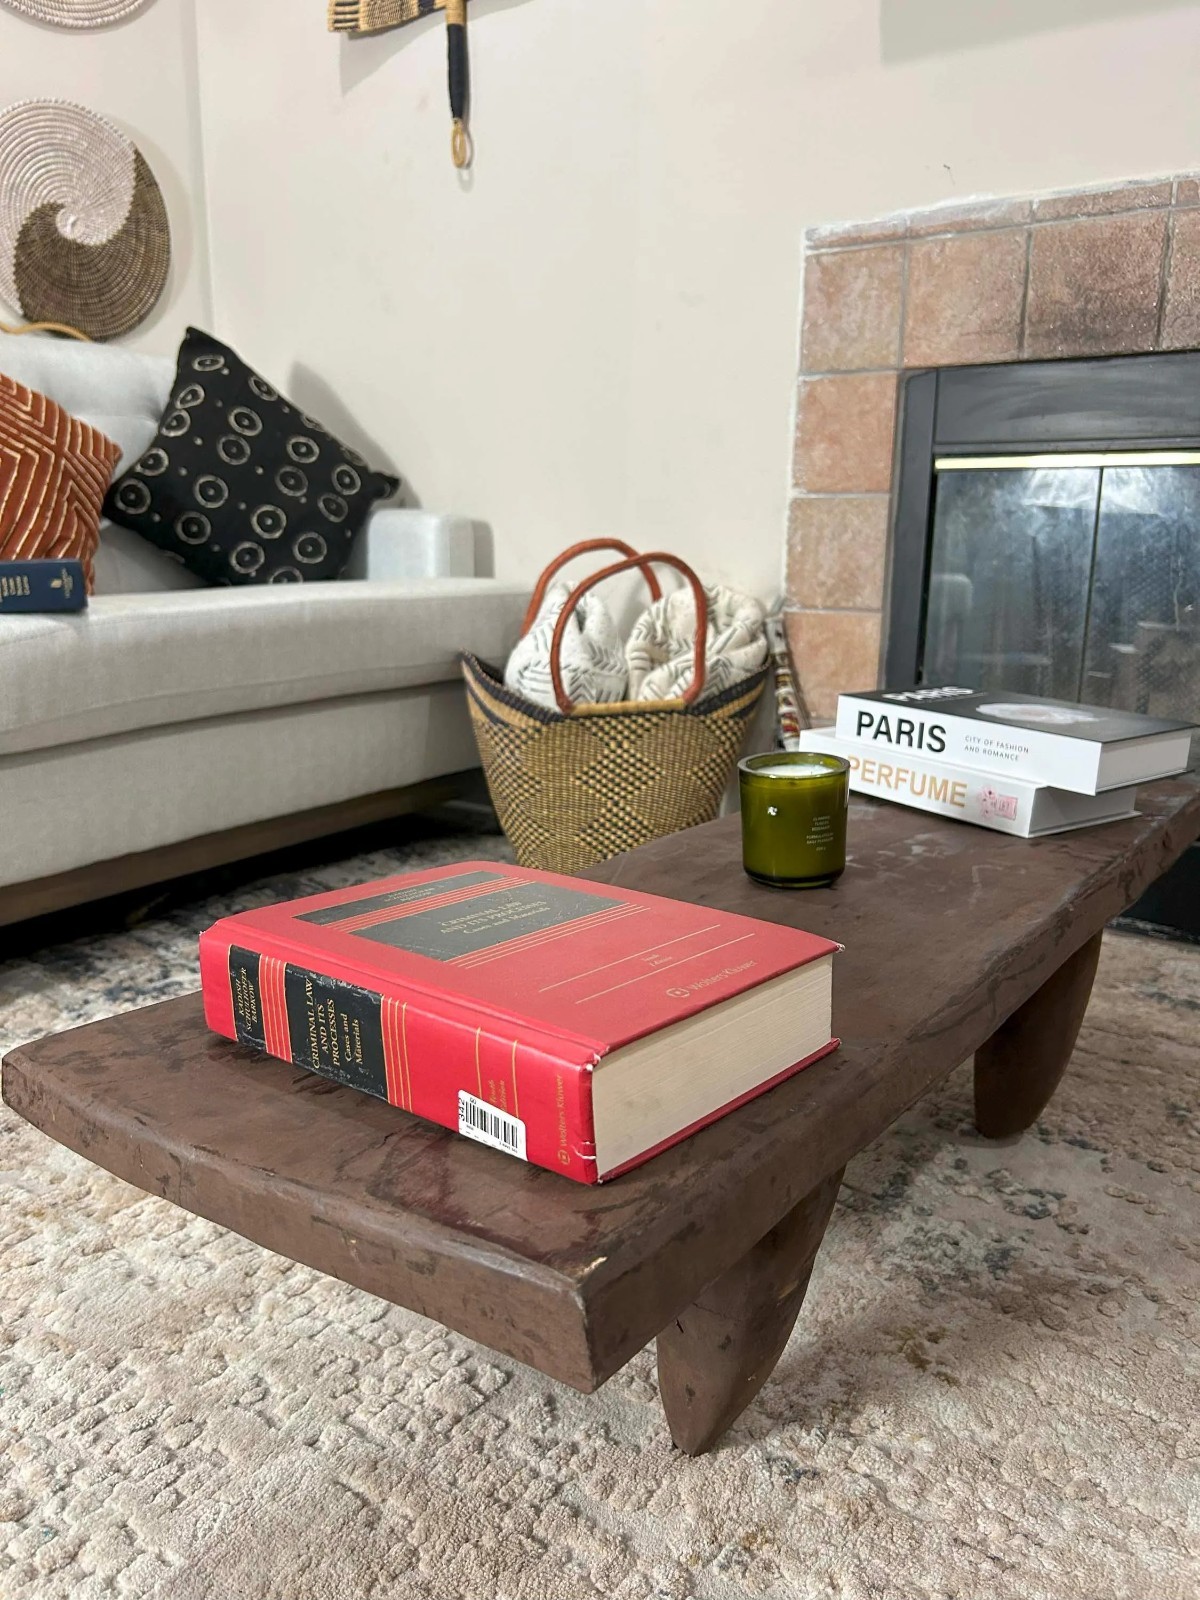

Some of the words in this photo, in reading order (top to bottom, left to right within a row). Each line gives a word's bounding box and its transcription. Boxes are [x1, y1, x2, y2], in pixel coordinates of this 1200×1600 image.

[856, 710, 947, 753] PARIS
[964, 735, 982, 744] CITY
[996, 741, 1029, 754] FASHION
[964, 745, 980, 753] AND
[982, 748, 1019, 761] ROMANCE
[848, 756, 967, 808] PERFUME
[235, 978, 245, 1016] KADISH
[305, 977, 314, 1006] LAW
[687, 972, 728, 990] Wolters
[241, 967, 253, 1032] SCHULHOFER
[248, 980, 258, 1023] BARKOW
[317, 1004, 326, 1023] ITS
[307, 1009, 320, 1069] CRIMINAL
[320, 1026, 329, 1053] AND
[327, 998, 340, 1066] PROCESSES
[340, 1013, 349, 1032] and
[344, 1034, 352, 1062] Cases
[352, 1019, 363, 1065] Materials
[555, 1074, 565, 1108] Kluwer
[558, 1111, 567, 1147] Wolters
